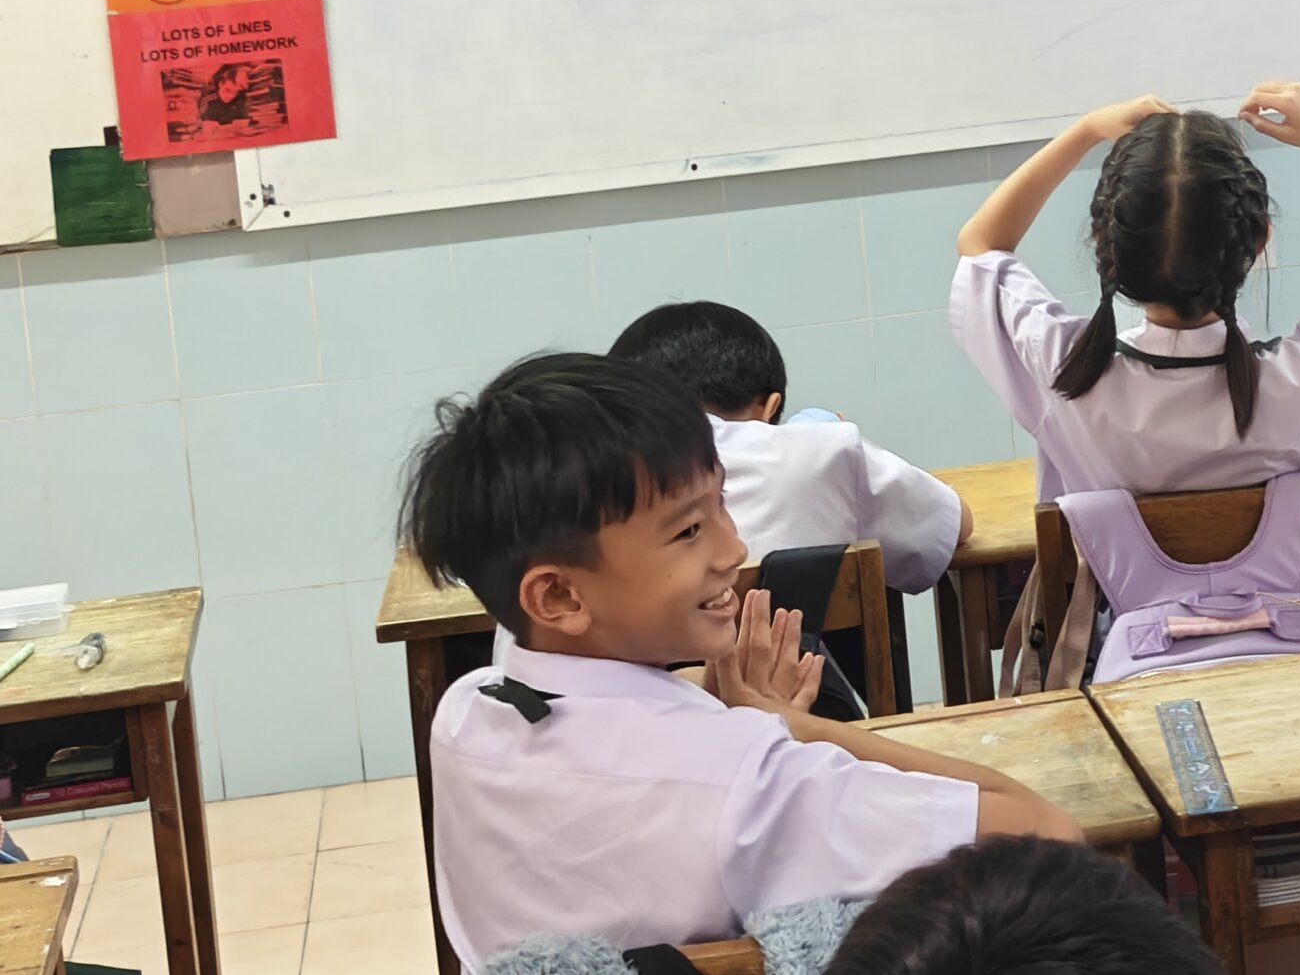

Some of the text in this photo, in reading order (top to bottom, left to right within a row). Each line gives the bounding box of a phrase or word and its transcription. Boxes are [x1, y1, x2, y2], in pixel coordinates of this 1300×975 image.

[162, 20, 273, 42] LOTS OF LINES
[141, 36, 298, 62] LOTS OF HOMEWORK
